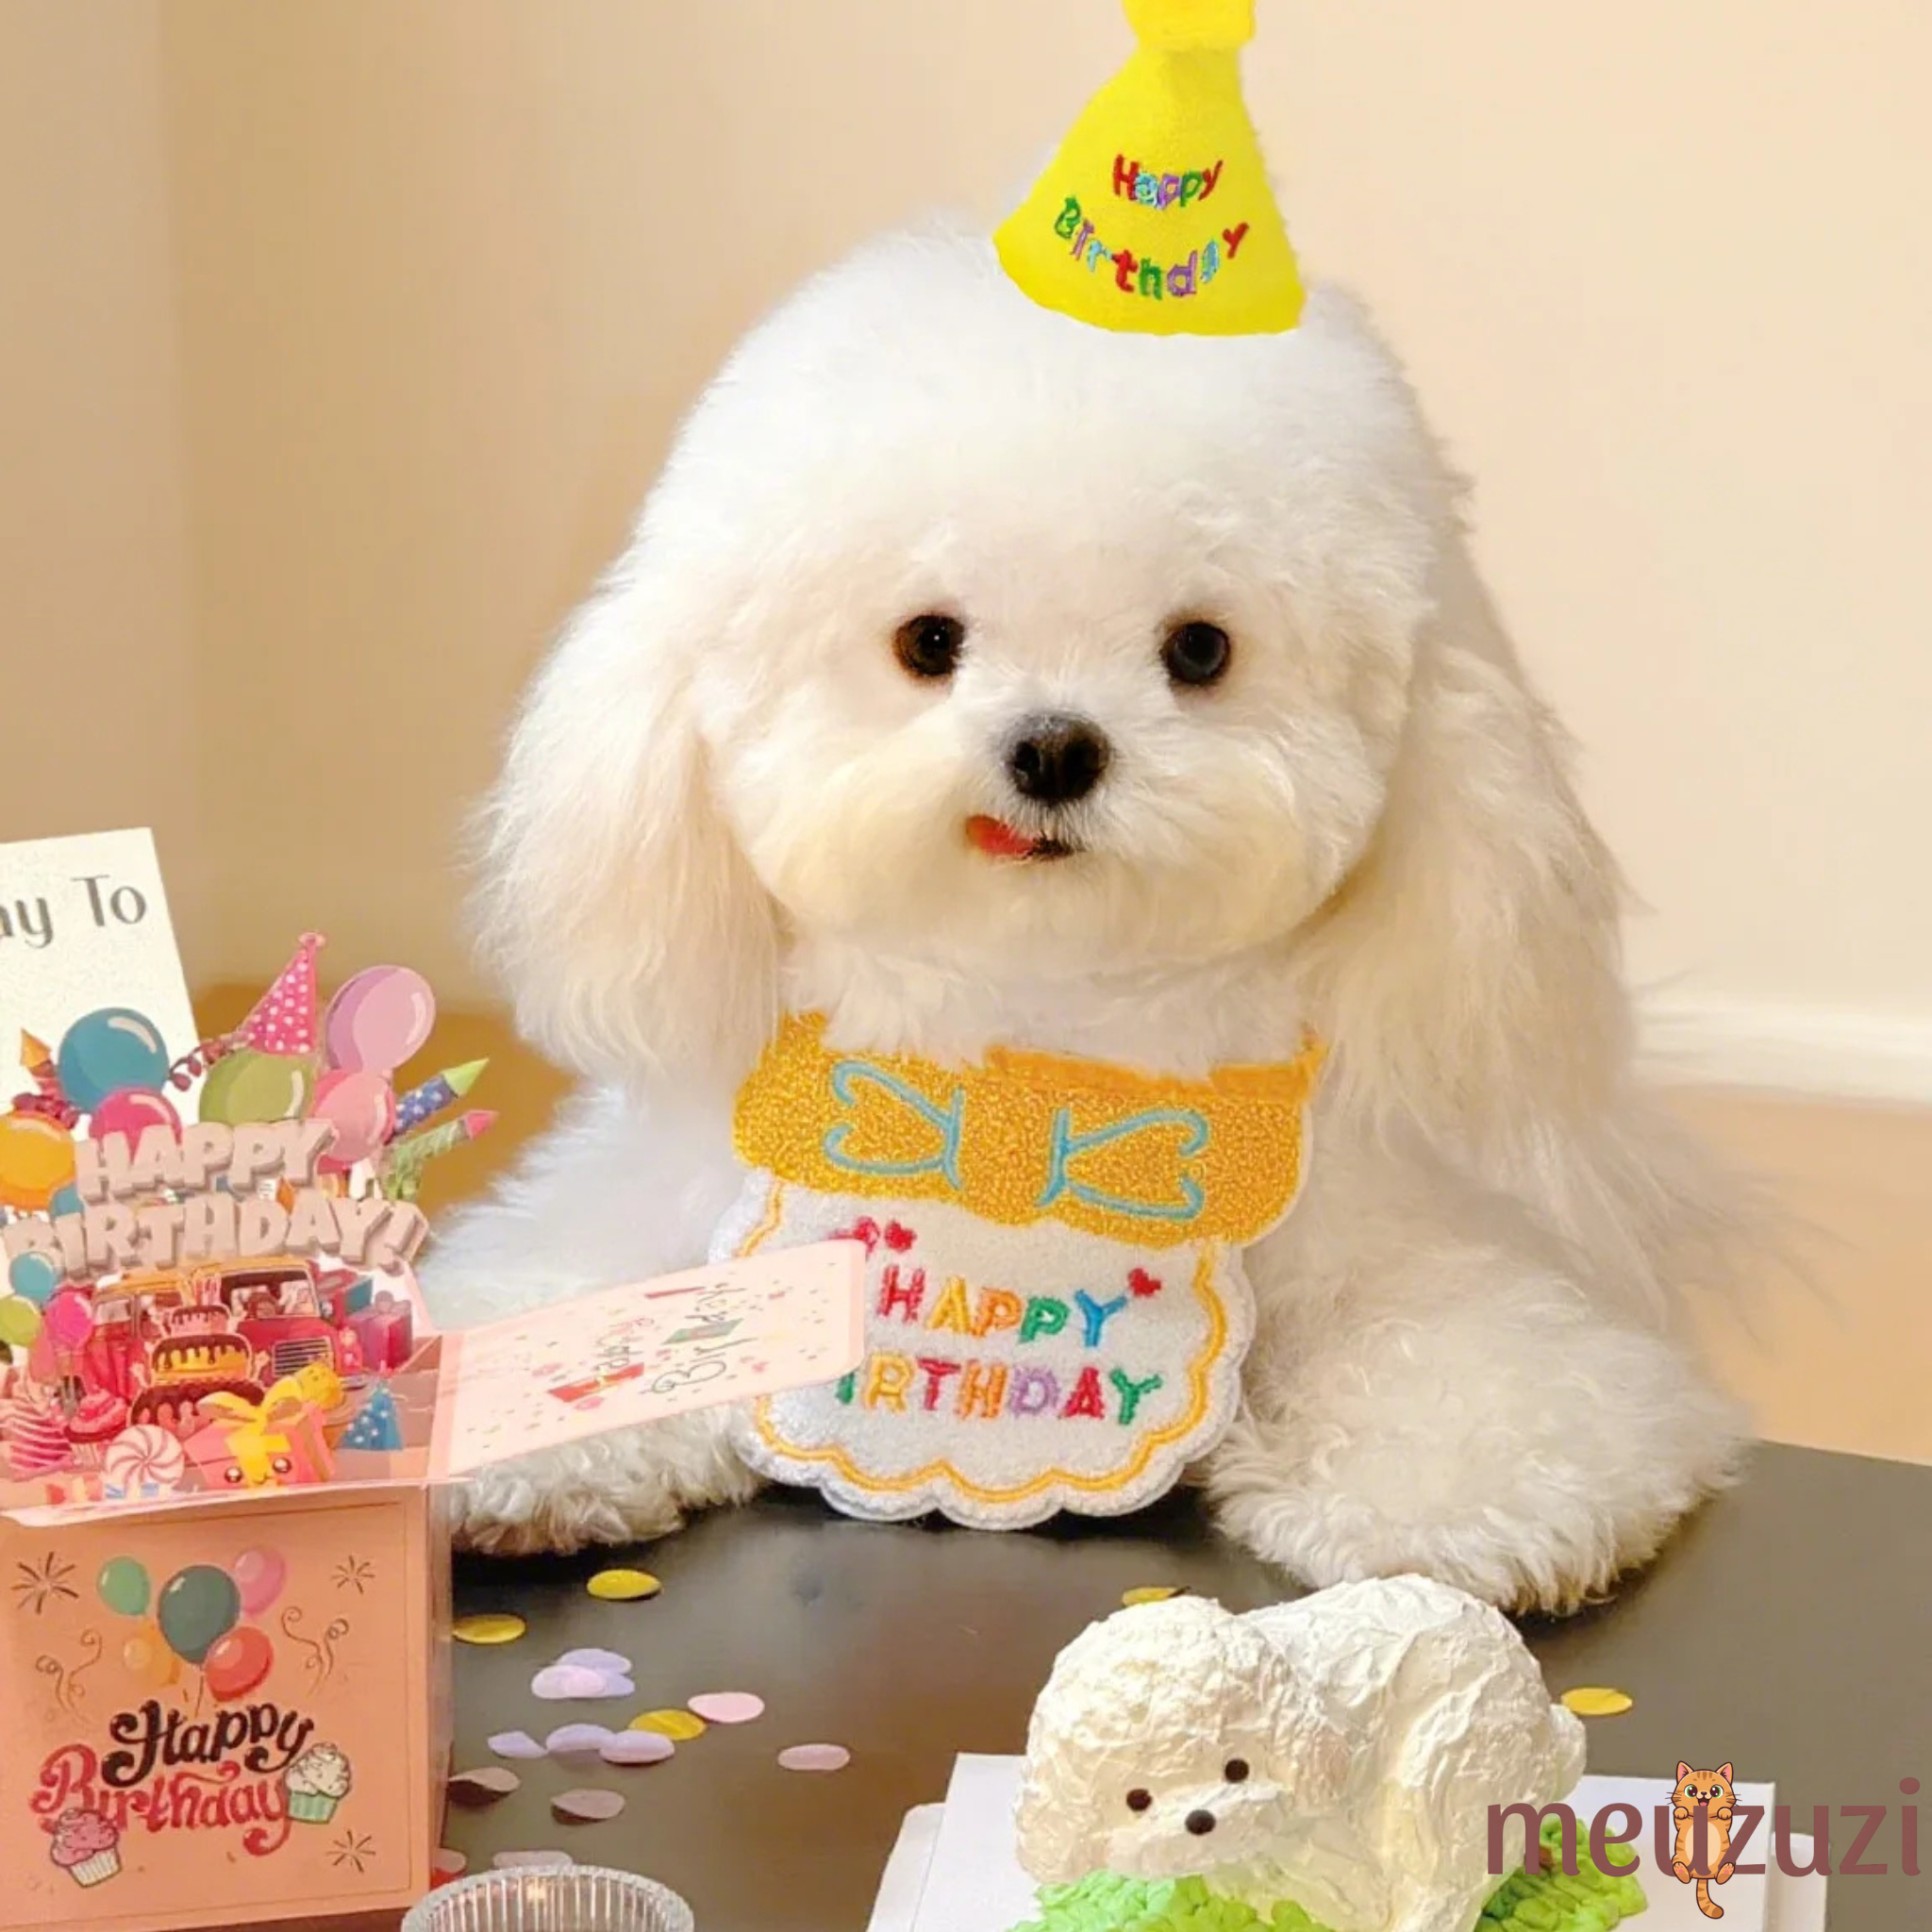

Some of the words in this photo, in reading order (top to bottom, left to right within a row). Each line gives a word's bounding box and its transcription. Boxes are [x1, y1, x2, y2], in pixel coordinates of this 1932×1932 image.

[1112, 154, 1224, 209] Happy
[70, 874, 146, 926] To
[75, 1119, 340, 1203] HAPPY
[875, 1263, 1128, 1347] HAPPY
[834, 1349, 1165, 1426] IRTHDAY
[101, 1699, 314, 1788] Happy
[28, 1743, 292, 1857] Birthday
